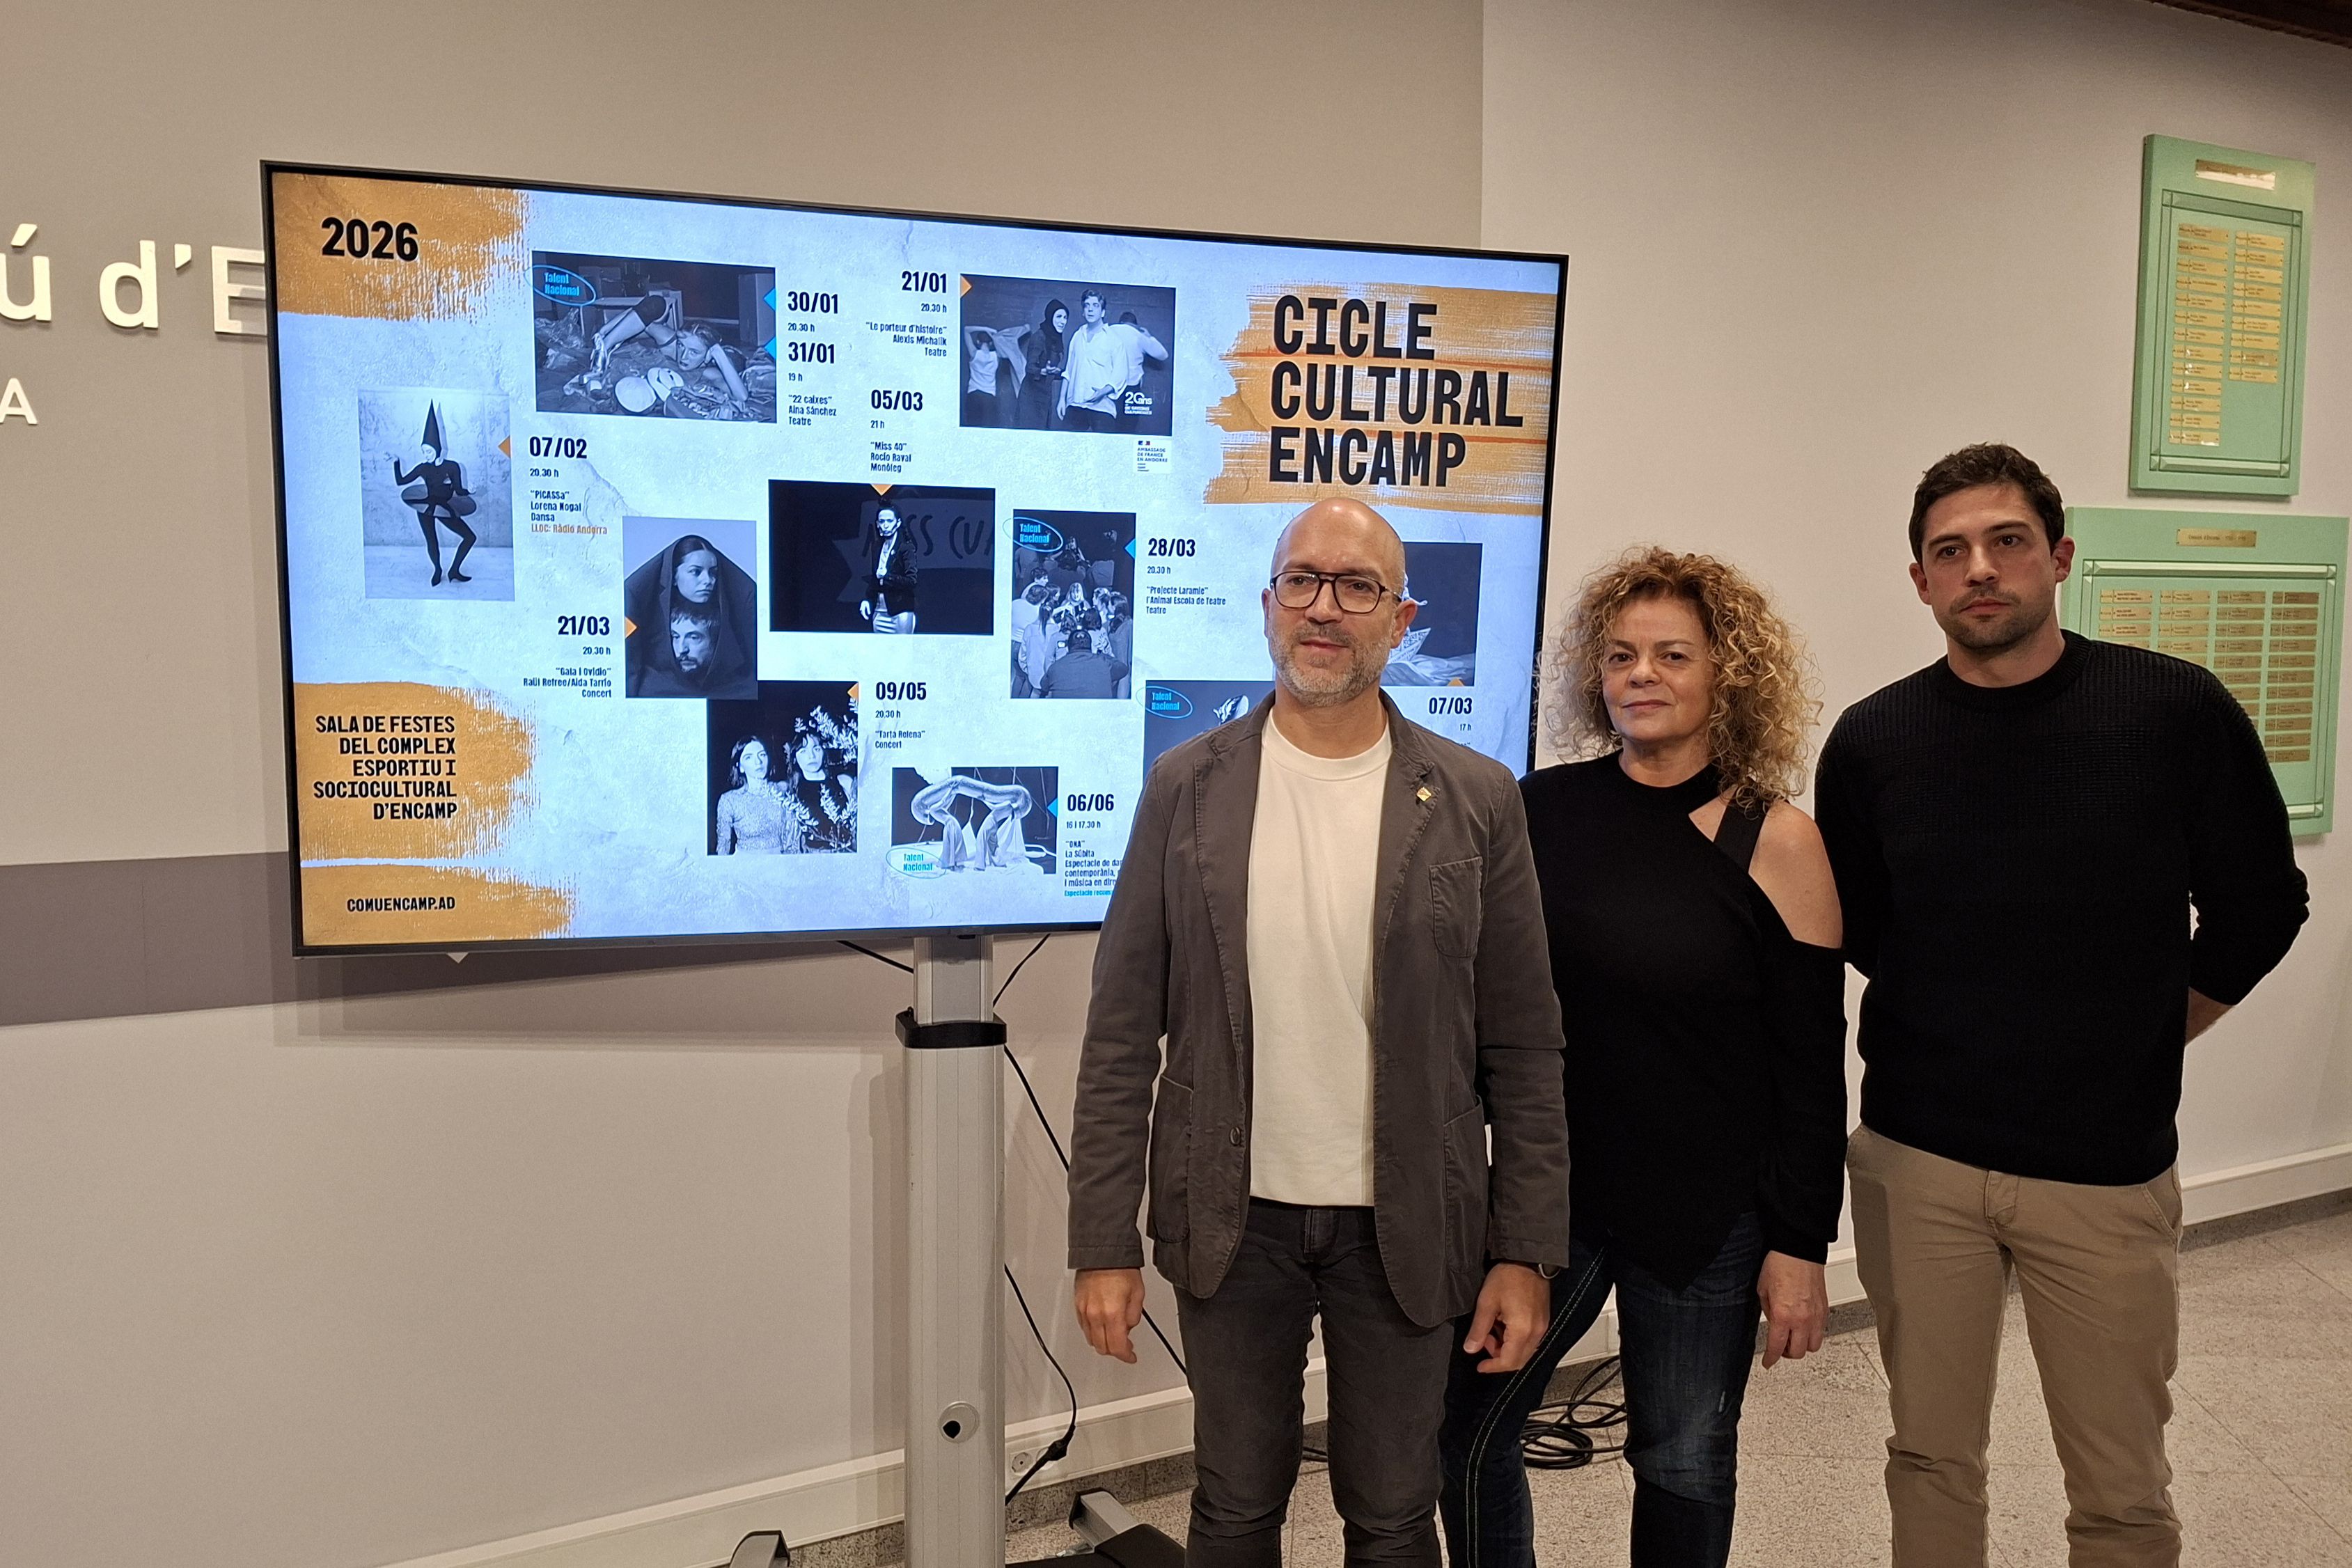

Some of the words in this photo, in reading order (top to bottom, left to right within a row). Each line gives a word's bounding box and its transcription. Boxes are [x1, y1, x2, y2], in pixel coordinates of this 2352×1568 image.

[320, 217, 418, 261] 2026
[544, 272, 569, 283] Talent
[902, 271, 947, 293] 21/01
[545, 284, 579, 296] Nacional
[787, 291, 838, 314] 30/01
[921, 303, 941, 312] 20.30
[943, 304, 947, 313] h
[787, 322, 808, 331] 20.30
[810, 324, 815, 332] h
[880, 323, 907, 333] porteur
[1273, 295, 1437, 360] CICLE
[893, 334, 914, 344] Alexis
[916, 336, 947, 346] Michalik
[788, 341, 834, 363] 31/01
[925, 347, 947, 356] Teatre
[788, 373, 796, 381] 19
[798, 373, 803, 382] h
[1271, 361, 1523, 427] CULTURAL
[0, 378, 38, 425] A
[871, 389, 923, 411] 05/03
[789, 405, 804, 415] Aina
[806, 405, 837, 416] Sánchez
[789, 416, 811, 425] Teatre
[870, 420, 878, 428] 21
[880, 420, 885, 429] h
[529, 436, 587, 459] 07/02
[870, 452, 891, 461] Rocío
[893, 453, 911, 462] Raval
[1269, 427, 1465, 487] ENCAMP
[530, 468, 551, 478] 20.30
[554, 469, 559, 478] h
[870, 462, 902, 473] Monòleg
[531, 501, 557, 510] Lorena
[560, 502, 581, 512] Nogal
[531, 512, 555, 522] Dansa
[531, 524, 551, 533] LLOC:
[553, 524, 574, 533] Ràdio
[577, 524, 607, 535] Andorra
[1020, 524, 1040, 533] Talent
[1020, 533, 1049, 543] Nacional
[1148, 538, 1195, 557] 28/03
[1147, 565, 1165, 574] 20.30
[1174, 596, 1194, 604] Escola
[558, 616, 610, 635] 21/03
[583, 646, 604, 655] 20.30
[606, 646, 611, 655] h
[524, 677, 540, 687] Raül
[590, 677, 611, 687] Tarrío
[582, 689, 611, 698] Concert
[876, 682, 926, 700] 09/05
[1152, 691, 1171, 700] Talent
[1152, 701, 1179, 710] Nacional
[1429, 697, 1473, 714] 07/03
[896, 710, 901, 719] h
[315, 716, 359, 732] SALA
[363, 716, 386, 732] DE
[390, 716, 455, 732] FESTES
[340, 737, 374, 754] DEL
[377, 737, 455, 754] COMPLEX
[353, 760, 441, 776] ESPORTIU
[446, 760, 456, 776] I
[313, 781, 457, 798] SOCIOCULTURAL
[1067, 794, 1114, 812] 06/06
[374, 803, 457, 820] D'ENCAMP
[904, 854, 923, 862] Talent
[1065, 849, 1072, 858] La
[904, 863, 932, 871] Nacional
[1065, 859, 1100, 868] Espectacle
[1068, 878, 1092, 887] música
[347, 897, 455, 912] COMUENCAMP.AD
